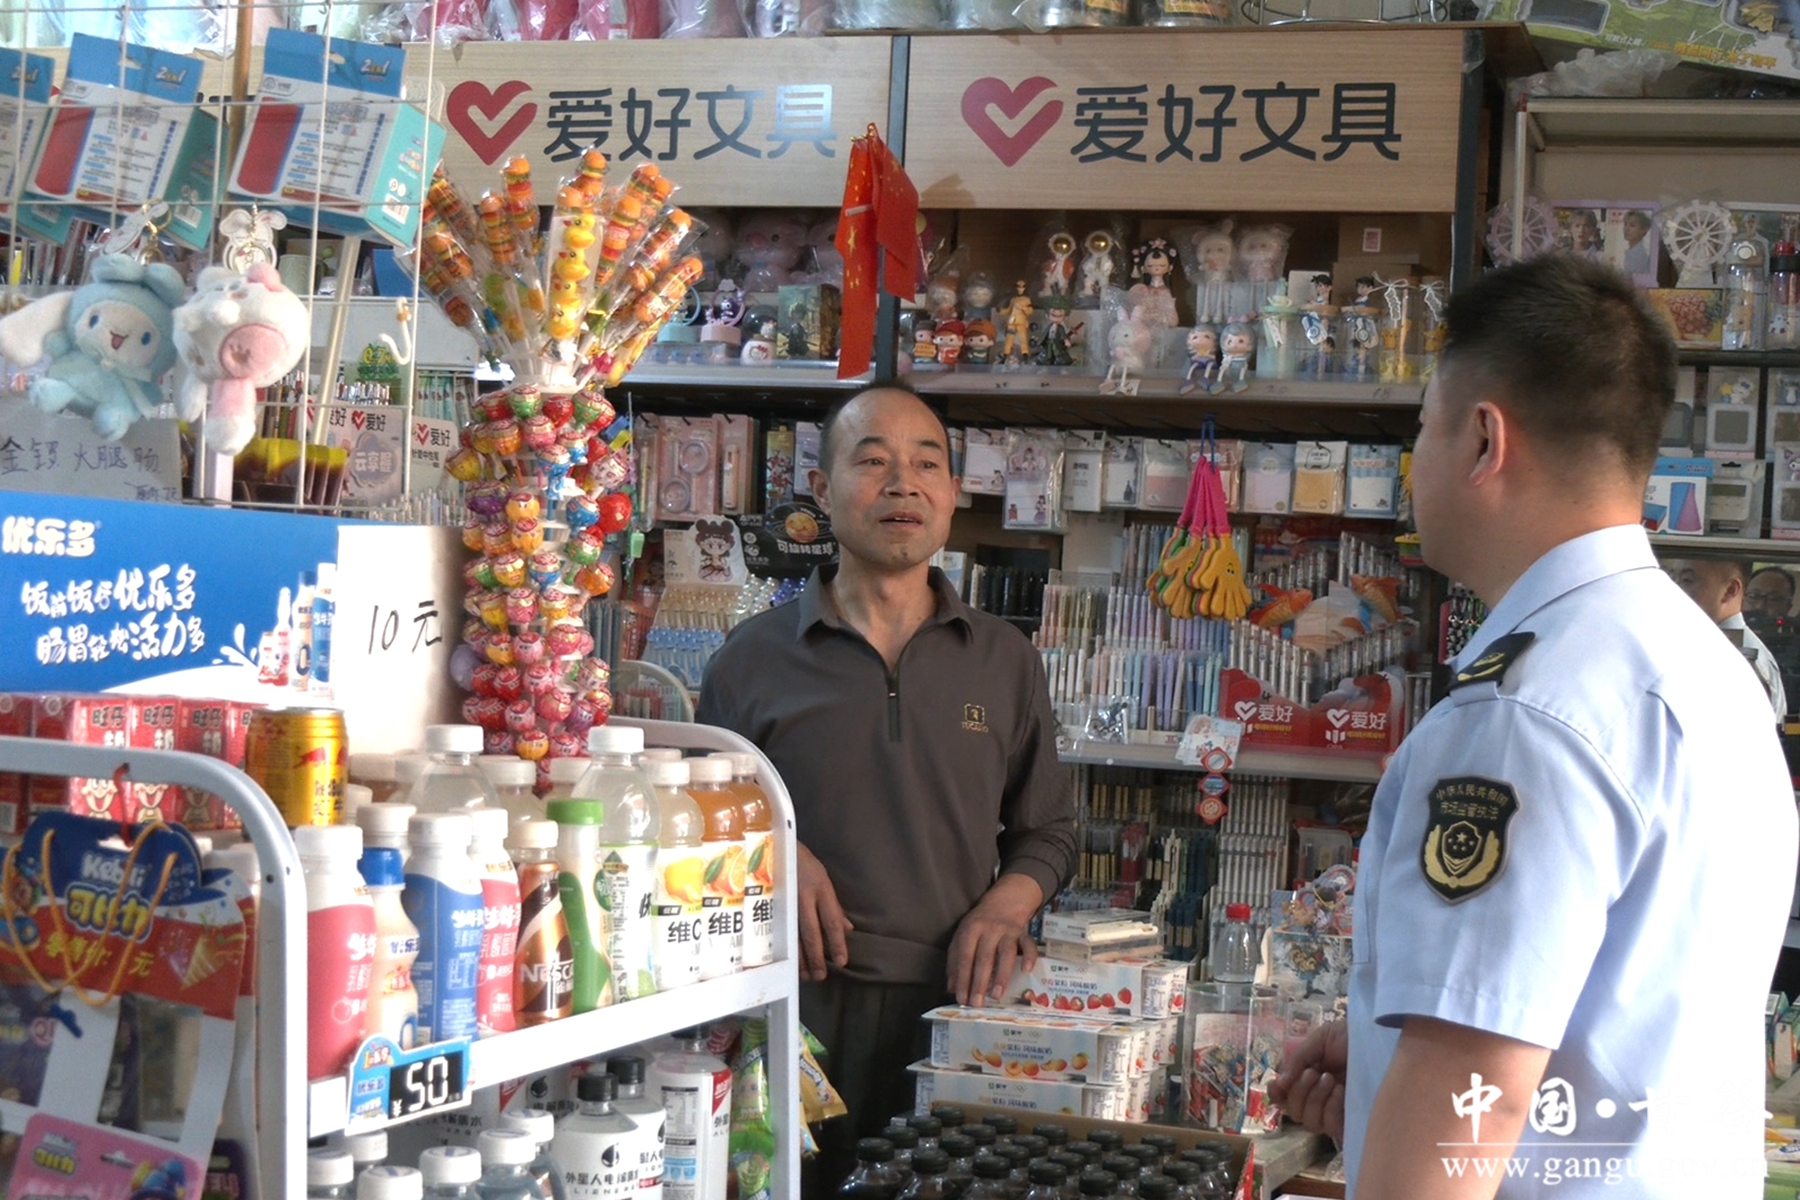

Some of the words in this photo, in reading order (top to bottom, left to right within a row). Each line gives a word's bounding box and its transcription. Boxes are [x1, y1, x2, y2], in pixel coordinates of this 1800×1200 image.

[544, 83, 837, 162] 爱好文具
[1070, 81, 1402, 163] 爱好文具
[366, 411, 386, 433] 爱好
[430, 427, 450, 448] 爱好
[2, 516, 96, 558] 优乐多
[21, 563, 196, 618] 饭前饭后优乐多
[37, 611, 206, 665] 肠胃轻松活力多
[368, 600, 443, 655] 10元
[92, 706, 125, 728] 旺仔
[143, 705, 175, 726] 旺仔
[192, 707, 223, 728] 旺仔
[1258, 704, 1293, 722] 爱好
[1351, 711, 1387, 730] 爱好
[1436, 783, 1510, 807] 中华人民共和国
[668, 918, 702, 943] 维C
[708, 911, 744, 935] 维B
[128, 952, 155, 978] 元
